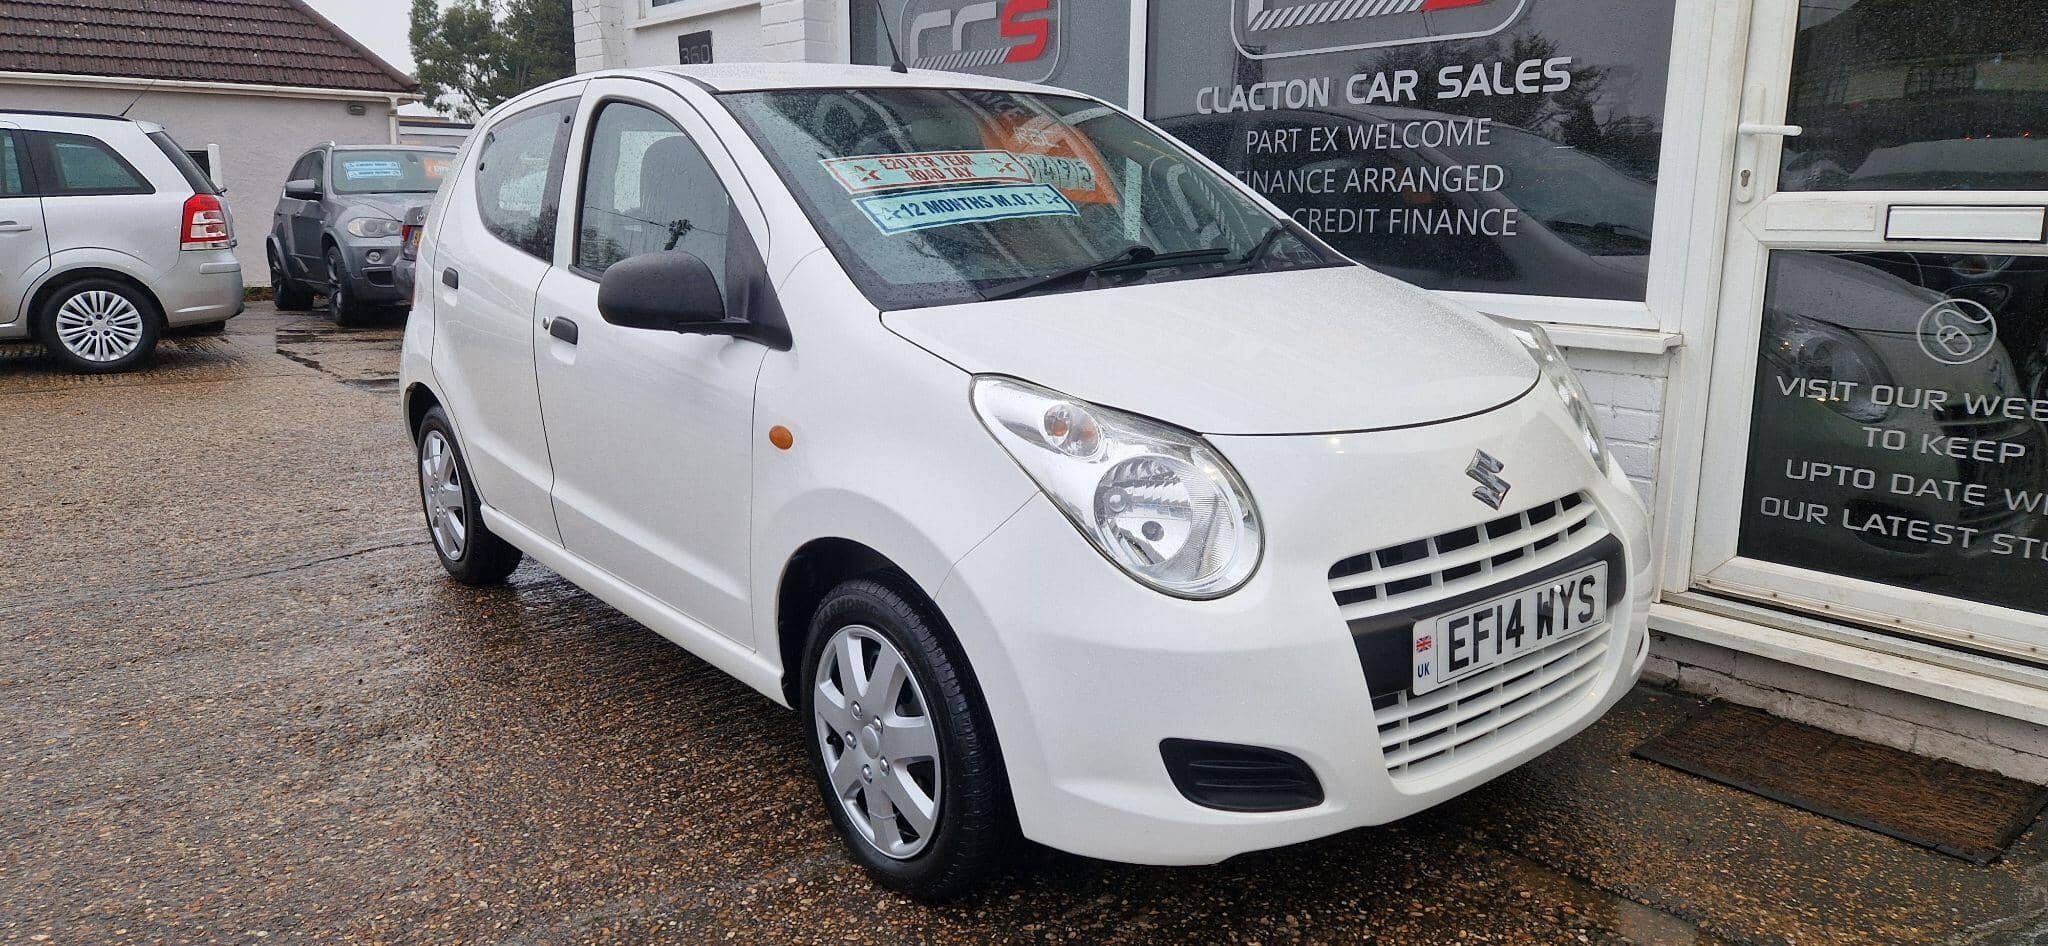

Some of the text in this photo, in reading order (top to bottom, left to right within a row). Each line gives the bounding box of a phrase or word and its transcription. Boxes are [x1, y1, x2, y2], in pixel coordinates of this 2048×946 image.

[1196, 56, 1572, 115] CLACTON CAR SALES
[1246, 117, 1492, 154] PART EX WELCOME
[878, 154, 977, 170] £20 PER YEAR
[905, 166, 977, 181] ROAD TAX
[1343, 164, 1505, 193] ARRANGED
[899, 203, 924, 217] 12
[925, 194, 989, 215] MONTHS
[1292, 208, 1518, 236] CREDIT FINANCE
[1777, 375, 1858, 402] VISIT
[1871, 384, 1947, 412] OUR
[1862, 426, 2026, 464] TO KEEP
[1785, 458, 1876, 490] UPTO
[1890, 473, 1988, 507] DATE
[1760, 496, 1829, 525] OUR
[1842, 508, 1979, 549] LATEST
[1449, 574, 1596, 673] EF14 WYS
[1417, 661, 1430, 678] UK
